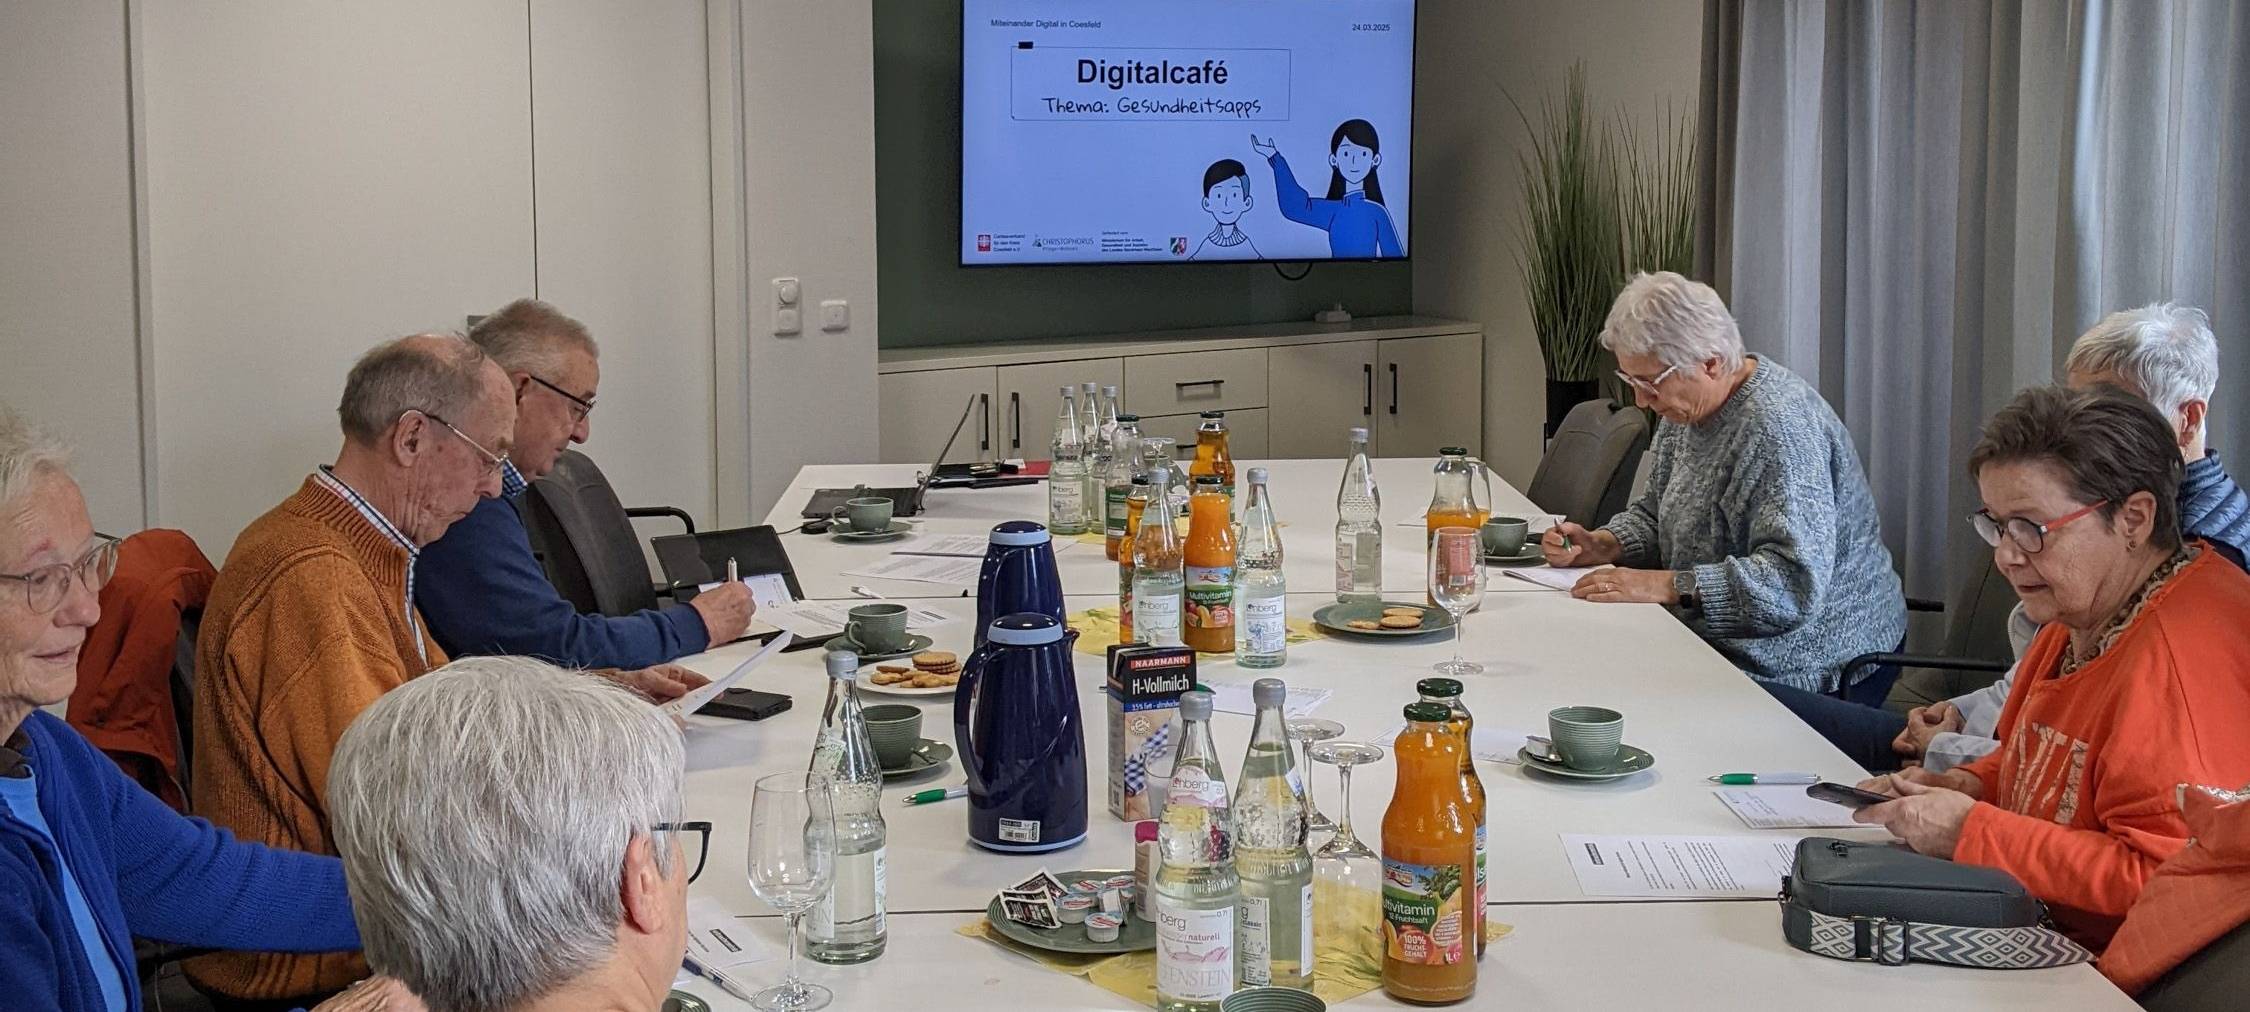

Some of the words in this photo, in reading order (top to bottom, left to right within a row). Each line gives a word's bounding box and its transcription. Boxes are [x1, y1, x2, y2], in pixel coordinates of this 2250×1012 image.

[991, 19, 1034, 28] Miteinander
[1036, 19, 1059, 30] Digital
[1060, 19, 1067, 28] in
[1069, 20, 1102, 29] Coesfeld
[1351, 23, 1391, 32] 24.03.2025
[1077, 59, 1229, 90] Digitalcafé
[1042, 97, 1110, 114] Thema:
[1117, 96, 1262, 118] Gesundheitsapps
[1135, 656, 1187, 668] NAARMANN
[1132, 673, 1190, 695] H-Vollmilch
[1404, 935, 1427, 945] 100%
